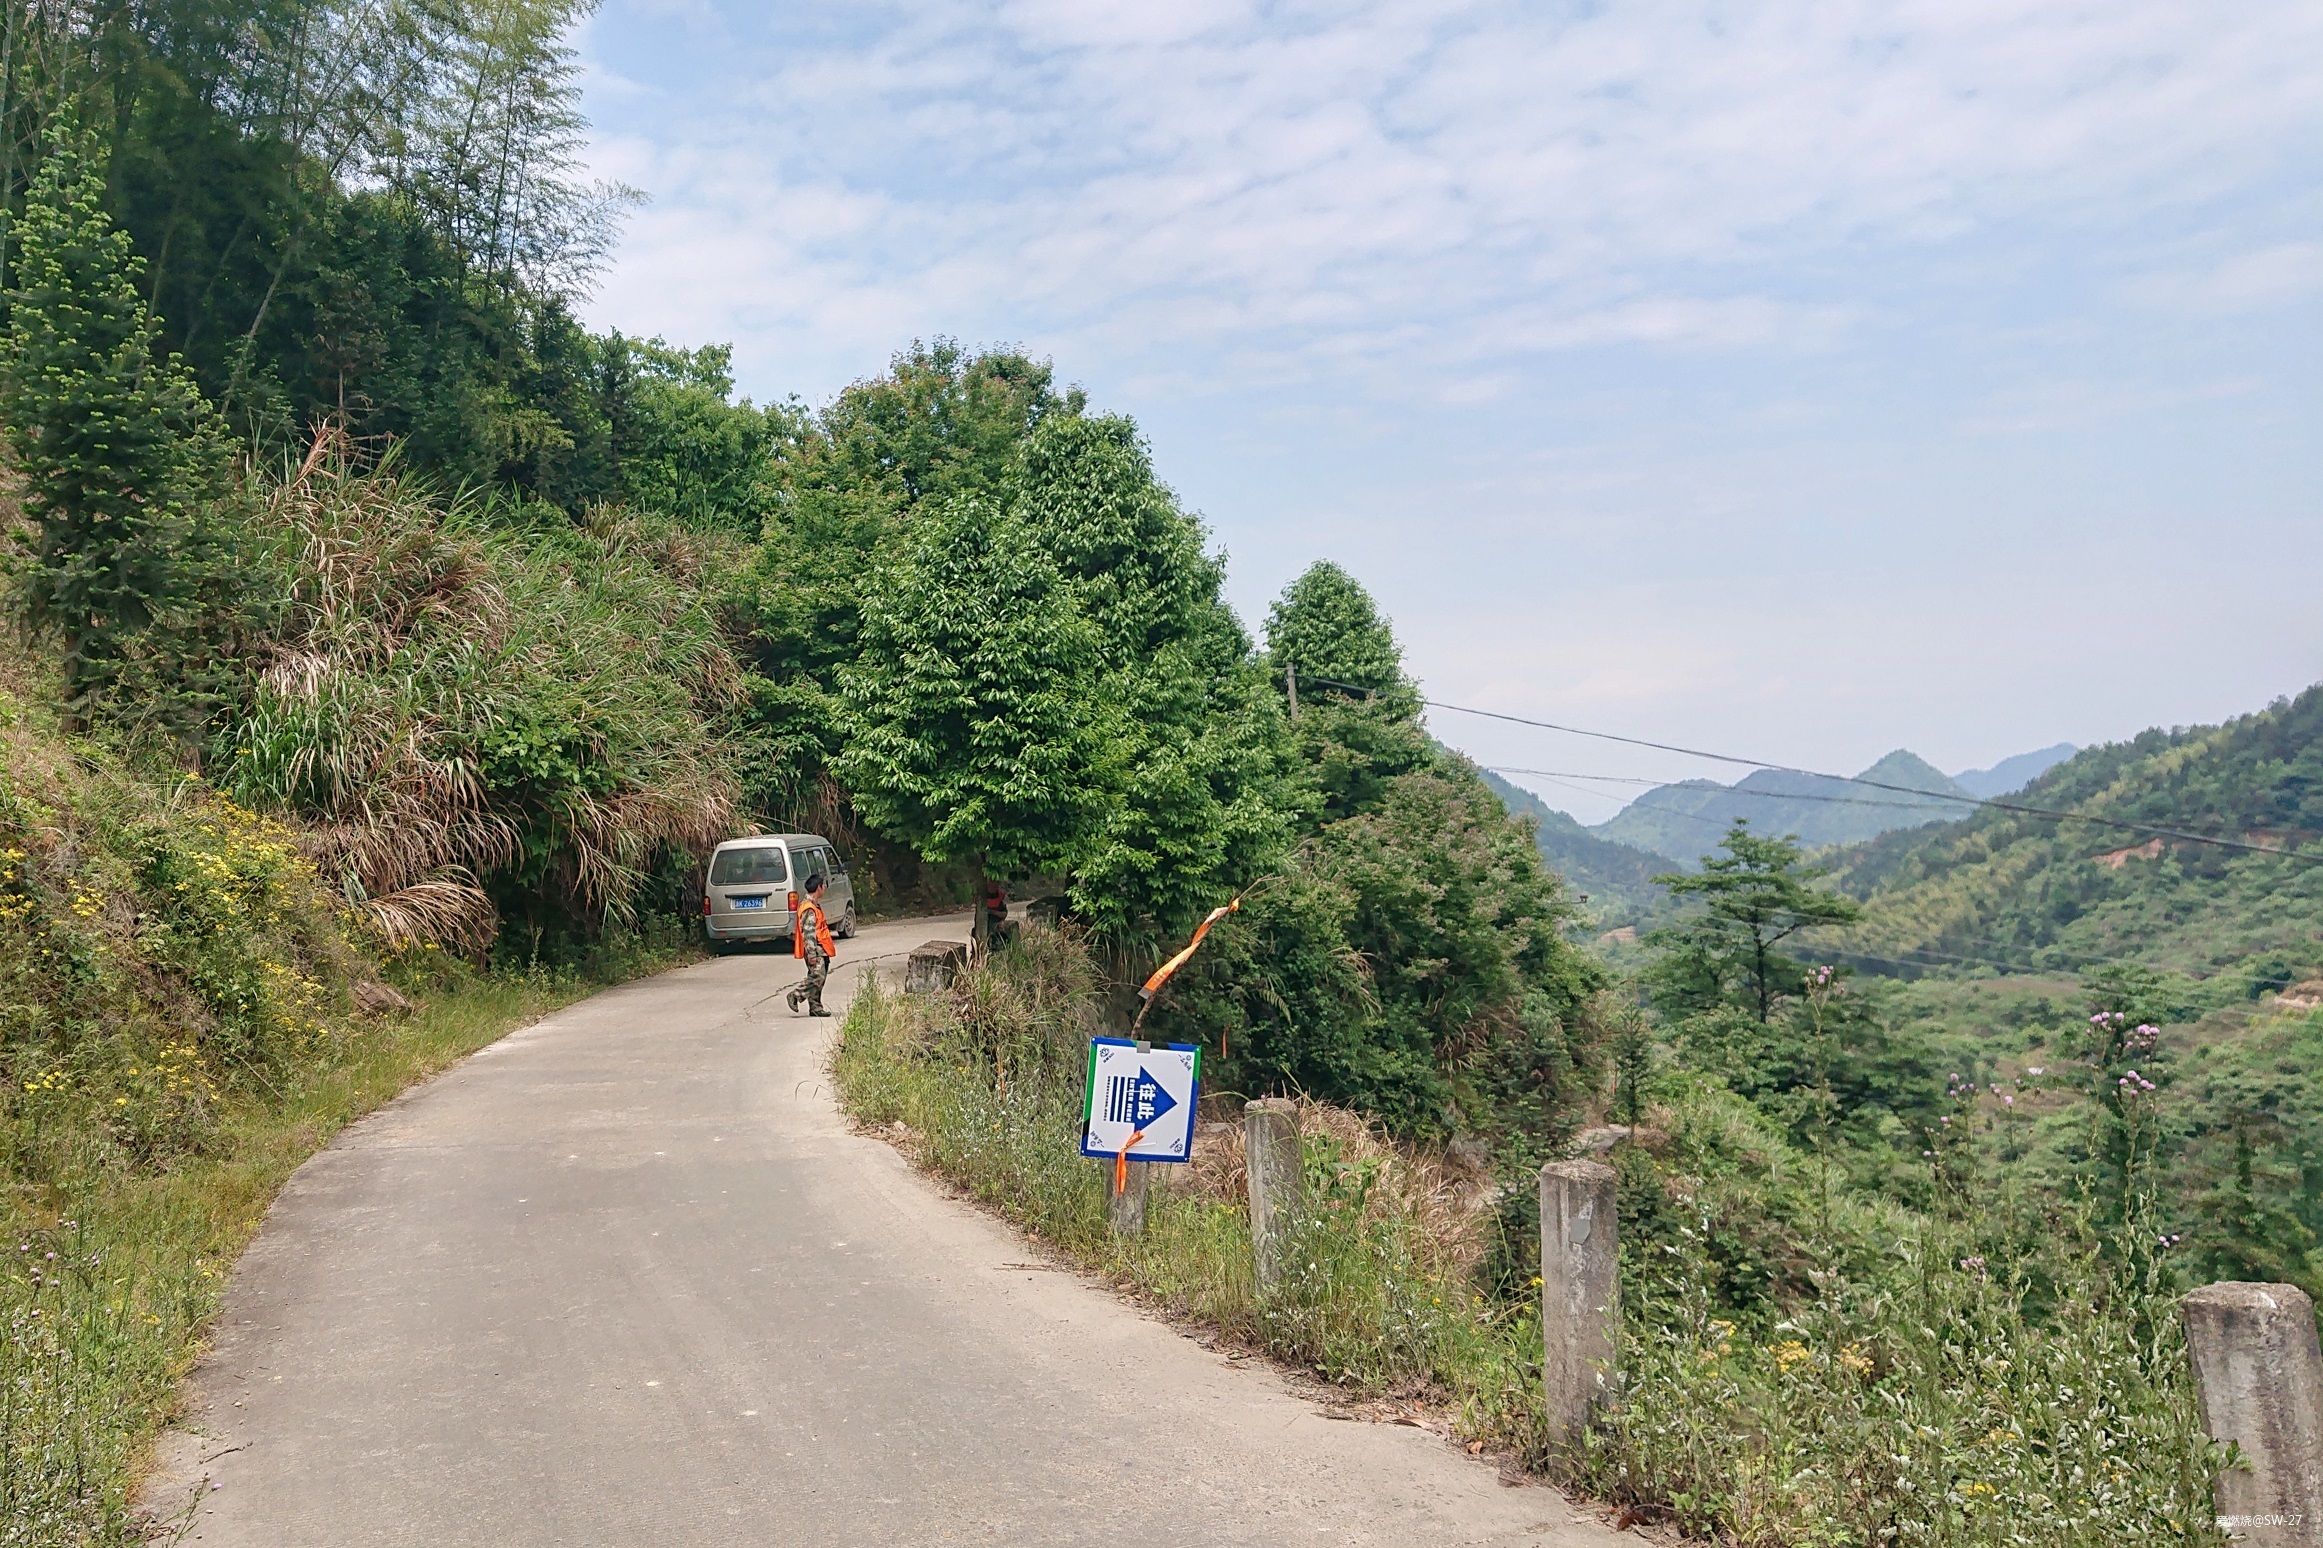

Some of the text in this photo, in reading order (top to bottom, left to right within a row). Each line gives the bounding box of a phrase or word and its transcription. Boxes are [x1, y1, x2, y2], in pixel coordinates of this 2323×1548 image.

[1125, 1078, 1135, 1122] ENTER HERE
[1137, 1083, 1156, 1120] 往此
